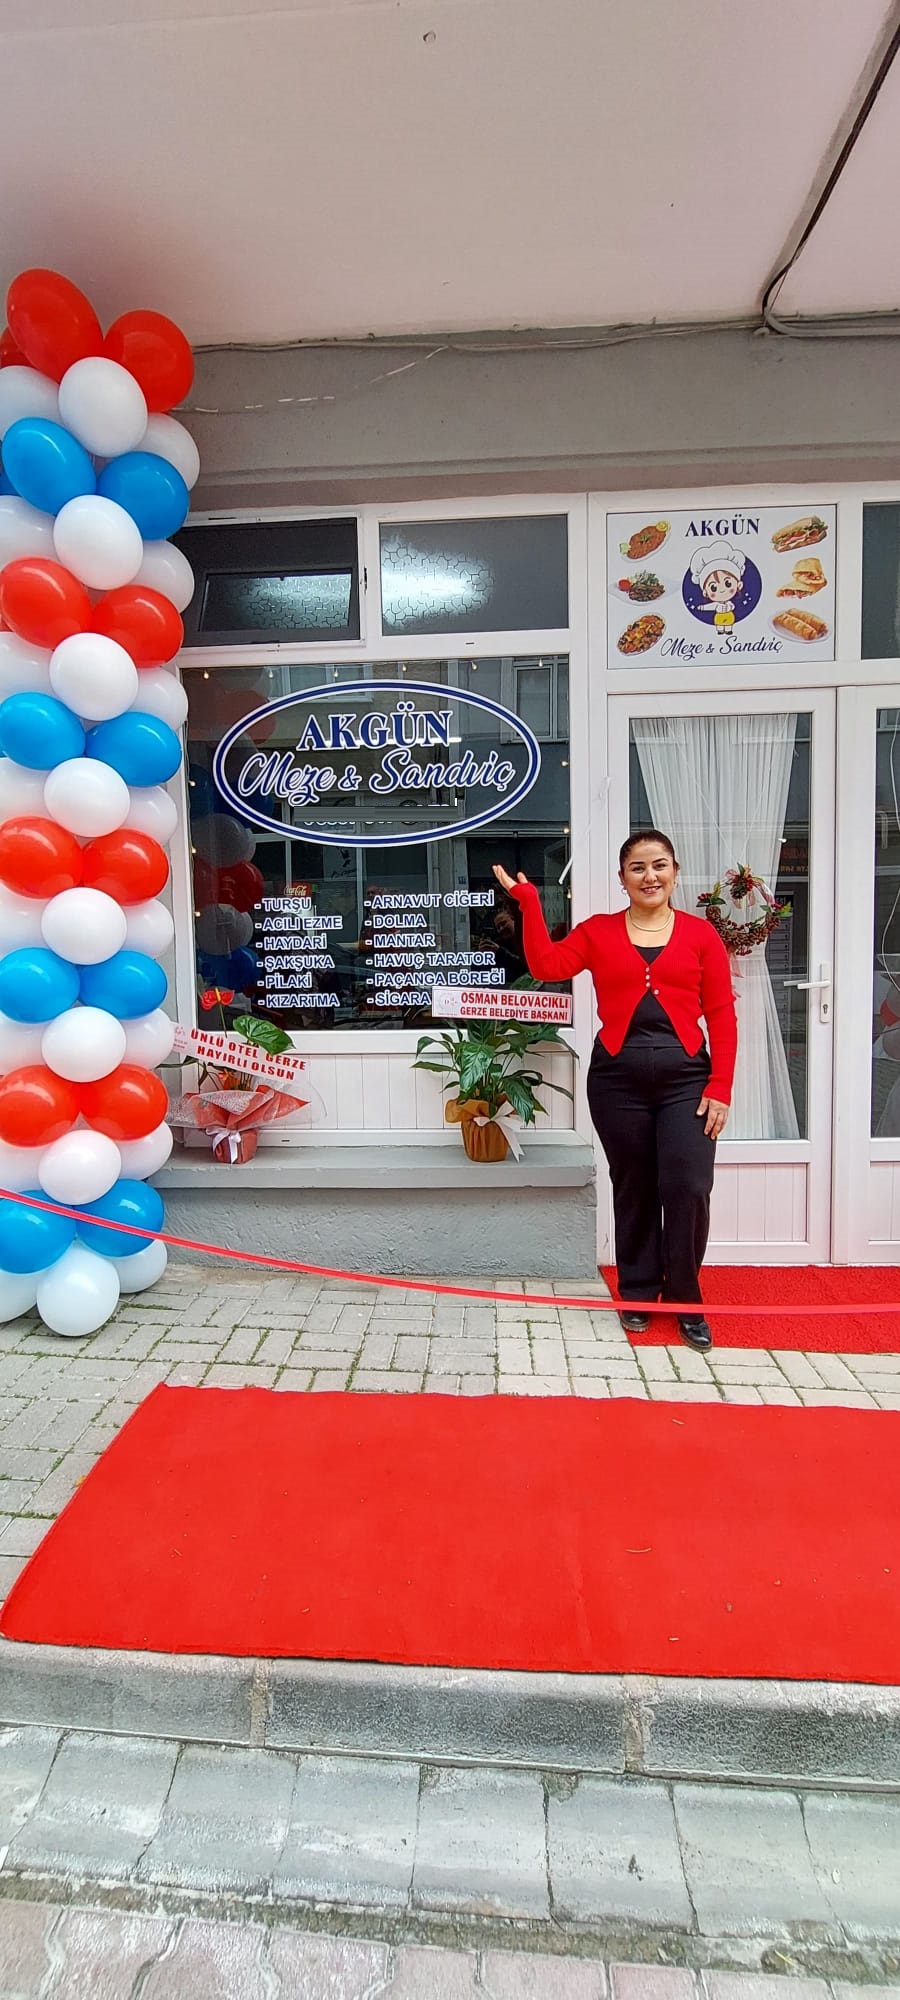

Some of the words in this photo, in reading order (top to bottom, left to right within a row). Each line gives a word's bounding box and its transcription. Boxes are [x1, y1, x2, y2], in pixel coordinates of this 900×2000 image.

[685, 514, 760, 537] AKGÜN
[661, 638, 704, 661] Meze
[706, 643, 715, 654] &
[719, 636, 783, 653] Sandviç
[297, 701, 453, 750] AKGÜN
[238, 751, 337, 806] Meze
[338, 765, 362, 790] &
[368, 748, 515, 793] Sandviç
[262, 897, 311, 913] TURŞU
[372, 894, 441, 909] ARNAVUT
[262, 917, 300, 930] ACILI
[303, 916, 343, 929] EZME
[373, 914, 427, 928] DOLMA
[263, 933, 327, 950] HAYDARİ
[373, 933, 436, 948] MANTAR
[264, 955, 335, 972] ŞAKŞUKA
[374, 953, 424, 969] HAVUÇ
[427, 951, 496, 966] TARATOR
[265, 972, 312, 988] PİLAKİ
[375, 972, 446, 989] PAÇANGA
[266, 993, 340, 1008] KIZARTMA
[375, 990, 431, 1006] SİGARA
[461, 992, 498, 1005] OSMAN
[500, 994, 568, 1009] BELOVACIKLI
[460, 1006, 487, 1017] GERZE
[197, 1046, 248, 1068] HAYIRLI
[251, 1062, 295, 1080] OLSUN
[228, 1041, 258, 1059] OTEL
[265, 1053, 307, 1071] GERZE
